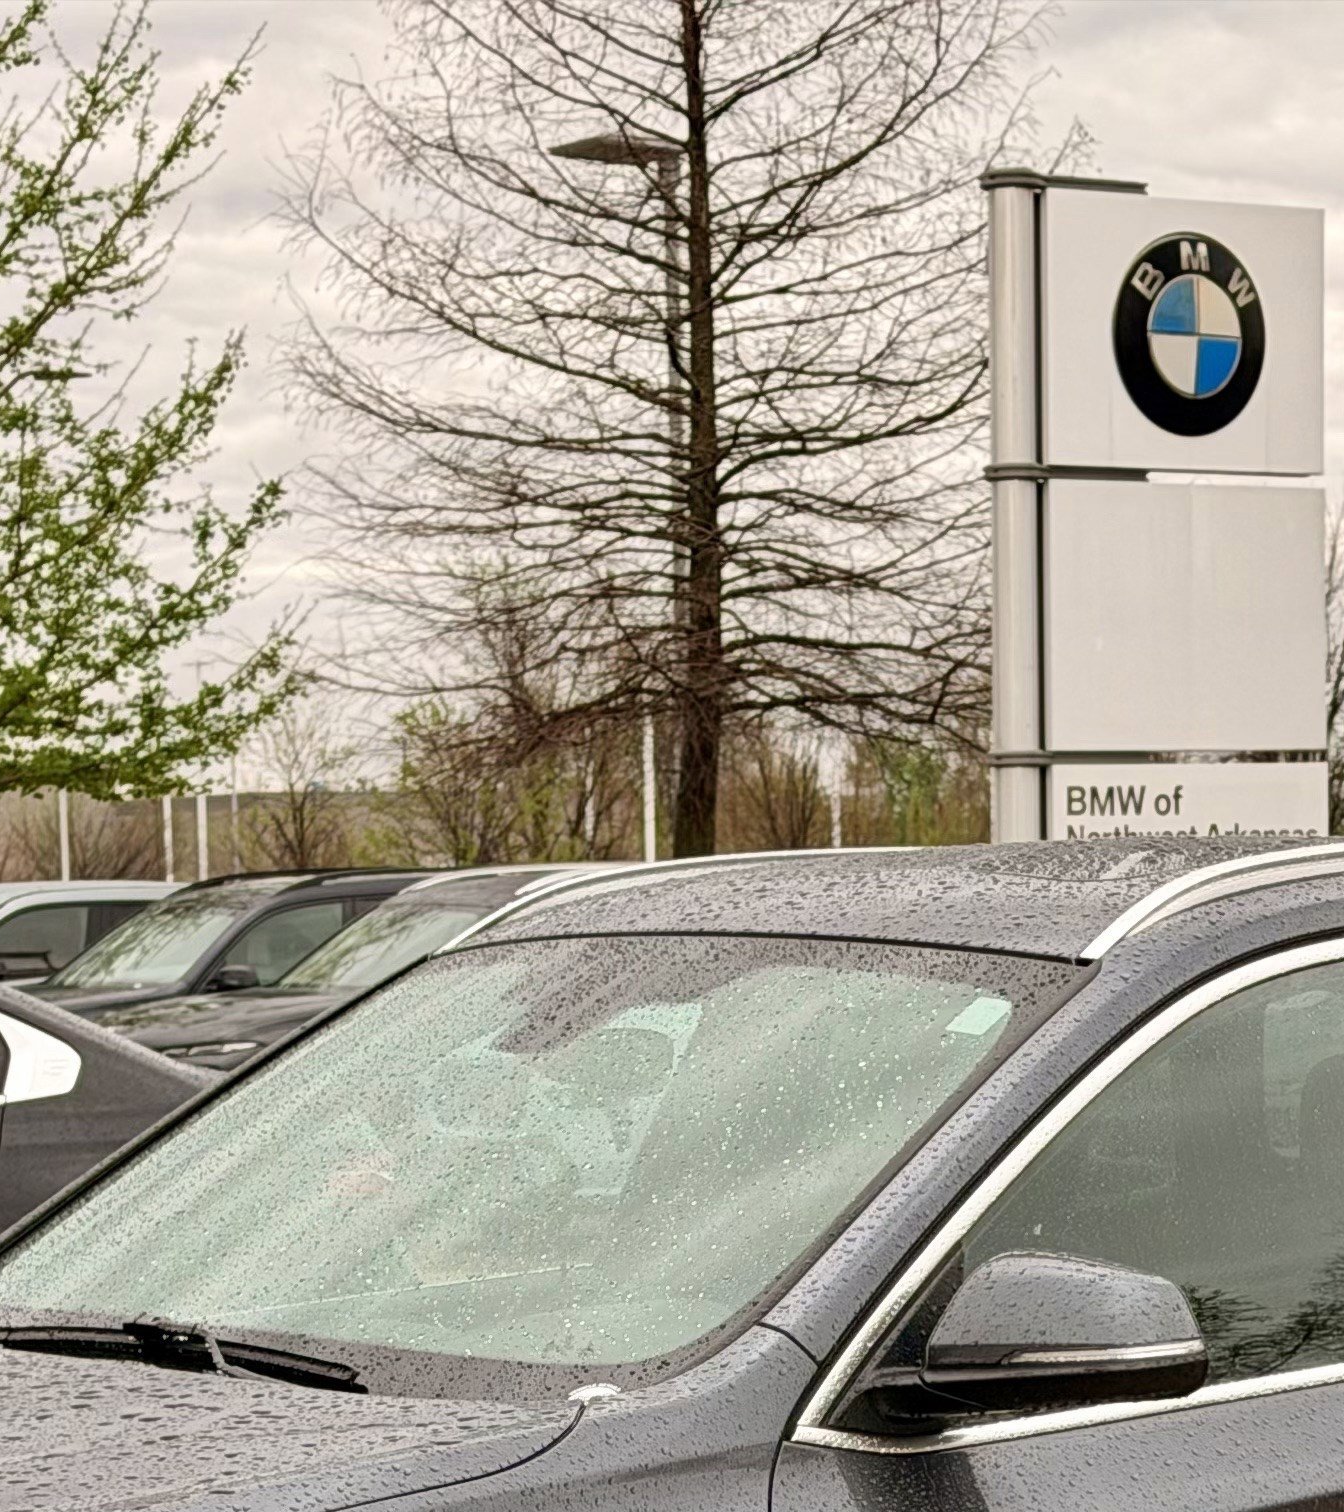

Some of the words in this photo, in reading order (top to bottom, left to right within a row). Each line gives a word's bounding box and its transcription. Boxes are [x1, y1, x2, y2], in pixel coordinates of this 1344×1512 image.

[1131, 240, 1255, 308] BMW
[1066, 785, 1146, 817] BMW
[1153, 785, 1184, 817] of
